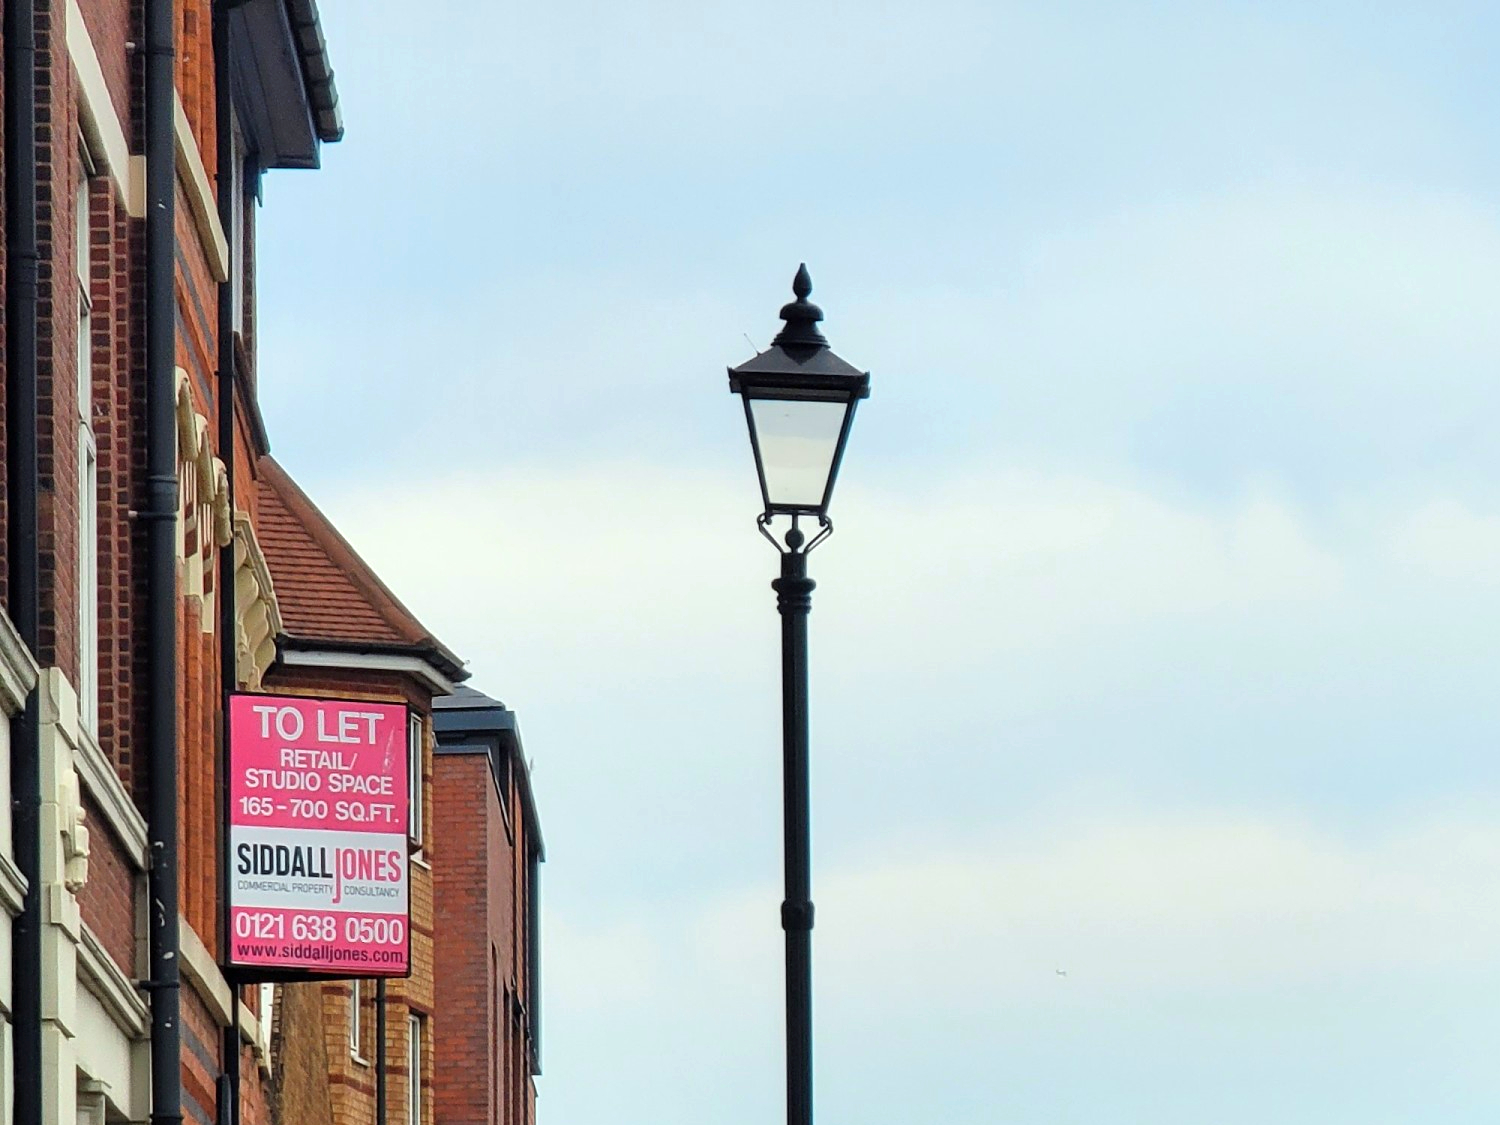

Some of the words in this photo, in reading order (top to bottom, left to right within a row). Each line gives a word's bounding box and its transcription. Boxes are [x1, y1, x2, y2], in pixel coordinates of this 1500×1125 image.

[253, 705, 304, 742] TO
[318, 708, 385, 745] LET
[280, 747, 358, 770] RETAIL/
[245, 768, 321, 793] STUDIO
[328, 773, 394, 796] SPACE
[335, 801, 400, 824] SQ.FT.
[237, 842, 334, 879] SIDDALL
[332, 847, 402, 904] JONES
[237, 880, 291, 893] COMMERCIAL
[292, 882, 335, 896] PROPERTY
[344, 885, 400, 898] CONSULTANCY
[235, 912, 285, 940] 0121
[292, 915, 337, 942] 638
[345, 917, 404, 945] 0500
[237, 942, 404, 965] www.siddalljones.com
